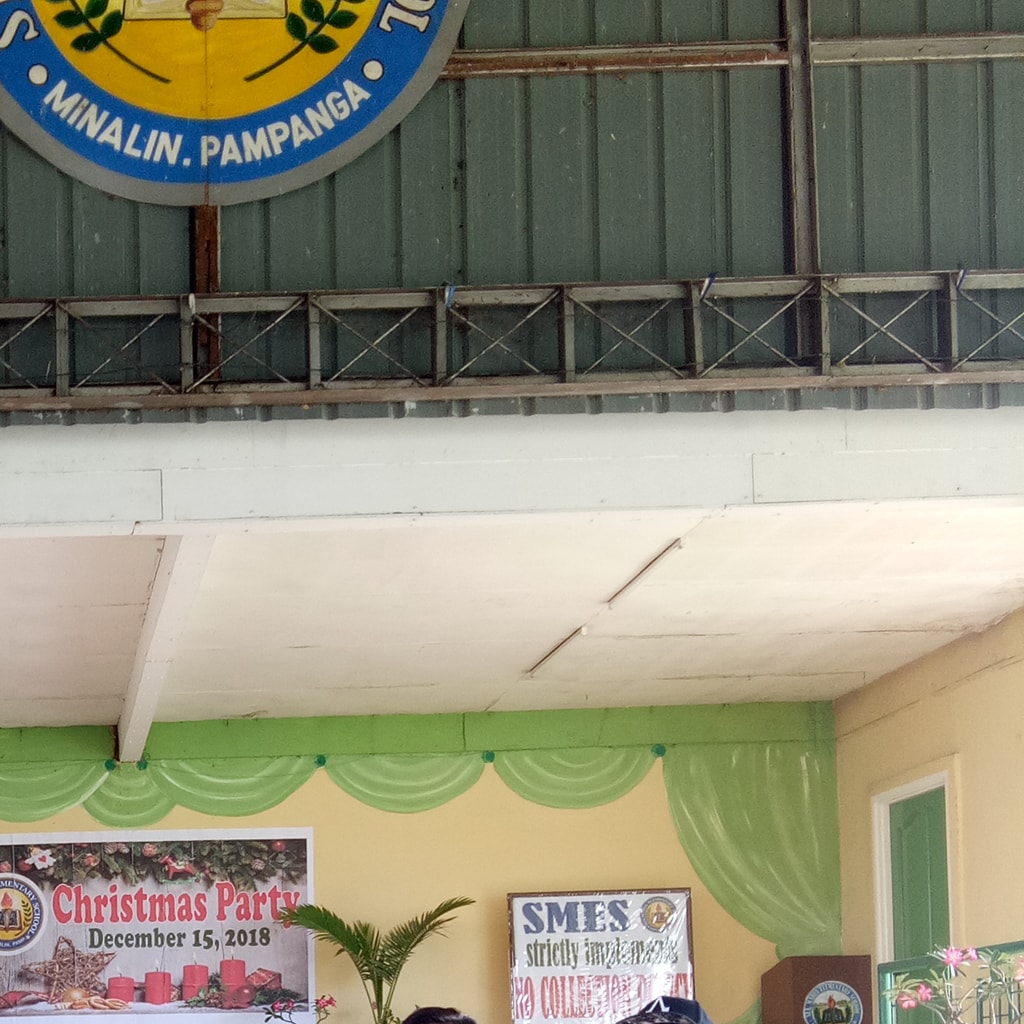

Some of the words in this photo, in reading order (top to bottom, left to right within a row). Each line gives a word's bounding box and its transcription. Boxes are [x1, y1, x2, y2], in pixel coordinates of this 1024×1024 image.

[200, 81, 372, 168] PAMPANGA
[29, 902, 41, 935] SCHOOL
[52, 883, 208, 924] Christmas
[215, 881, 301, 928] Party
[522, 900, 632, 934] SMES
[88, 927, 186, 949] December
[193, 930, 219, 951] 15,
[225, 927, 271, 947] 2018
[527, 938, 579, 970] strictly
[514, 976, 535, 1019] NO
